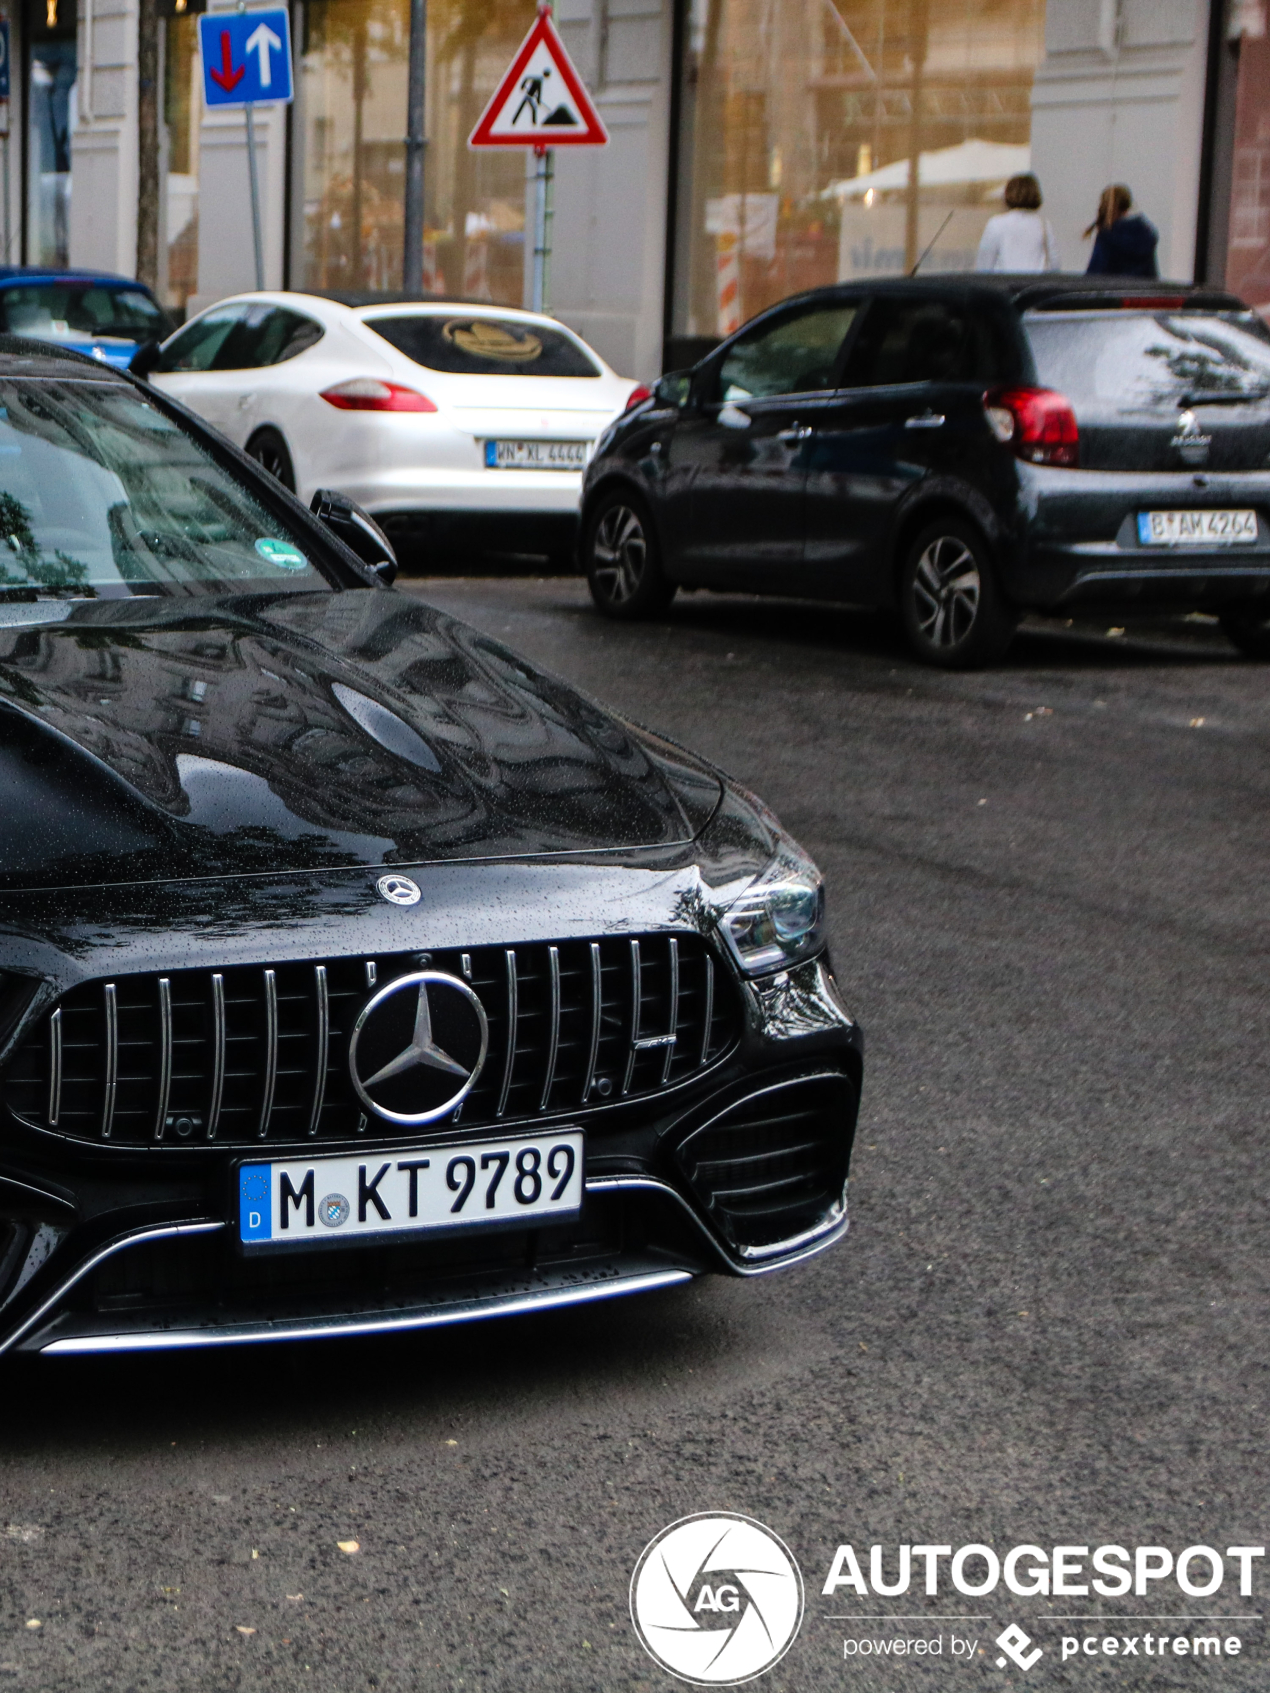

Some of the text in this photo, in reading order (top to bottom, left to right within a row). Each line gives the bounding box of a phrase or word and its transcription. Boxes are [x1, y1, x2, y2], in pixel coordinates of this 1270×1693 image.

[527, 442, 544, 461] XL
[549, 444, 583, 462] 4444
[1151, 512, 1254, 537] B AM 4264
[280, 1168, 315, 1230] M
[358, 1158, 431, 1223] KT
[445, 1143, 576, 1214] 9789
[248, 1211, 262, 1229] D
